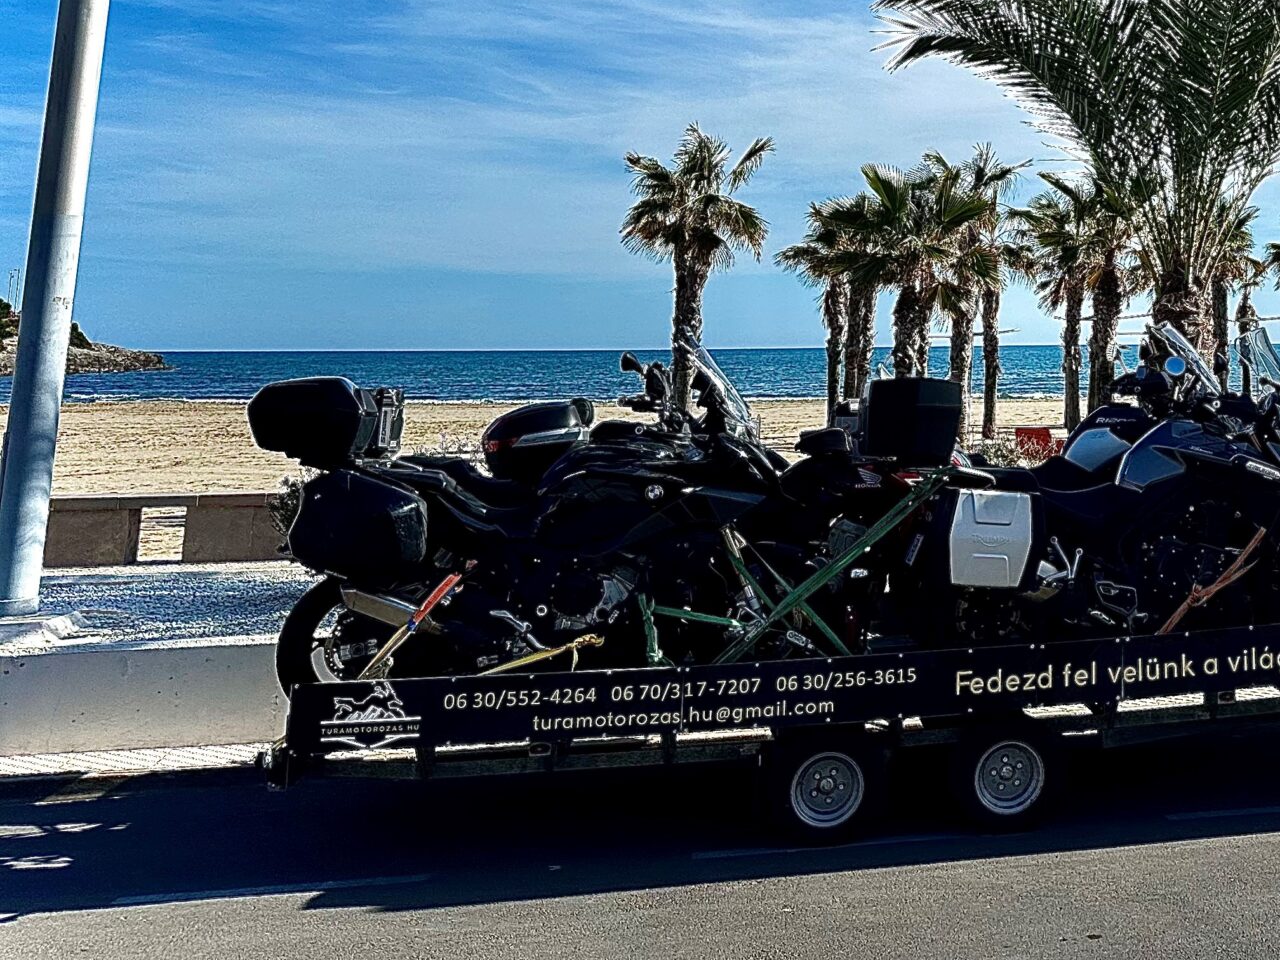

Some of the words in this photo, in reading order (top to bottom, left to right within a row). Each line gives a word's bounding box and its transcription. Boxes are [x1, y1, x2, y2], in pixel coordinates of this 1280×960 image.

[444, 693, 467, 709] 06
[472, 687, 597, 710] 30/552-4264
[611, 685, 634, 701] 06
[639, 678, 761, 702] 70/317-7207
[776, 676, 798, 691] 06
[802, 668, 917, 691] 30/256-3615
[956, 664, 1053, 695] Fedezd
[1062, 660, 1096, 687] fel
[1107, 653, 1196, 683] velünk
[1203, 658, 1218, 675] a
[321, 724, 420, 735] TURAMOTOROZASHU
[532, 700, 835, 731] turamotorozas.hu@gmail.com
